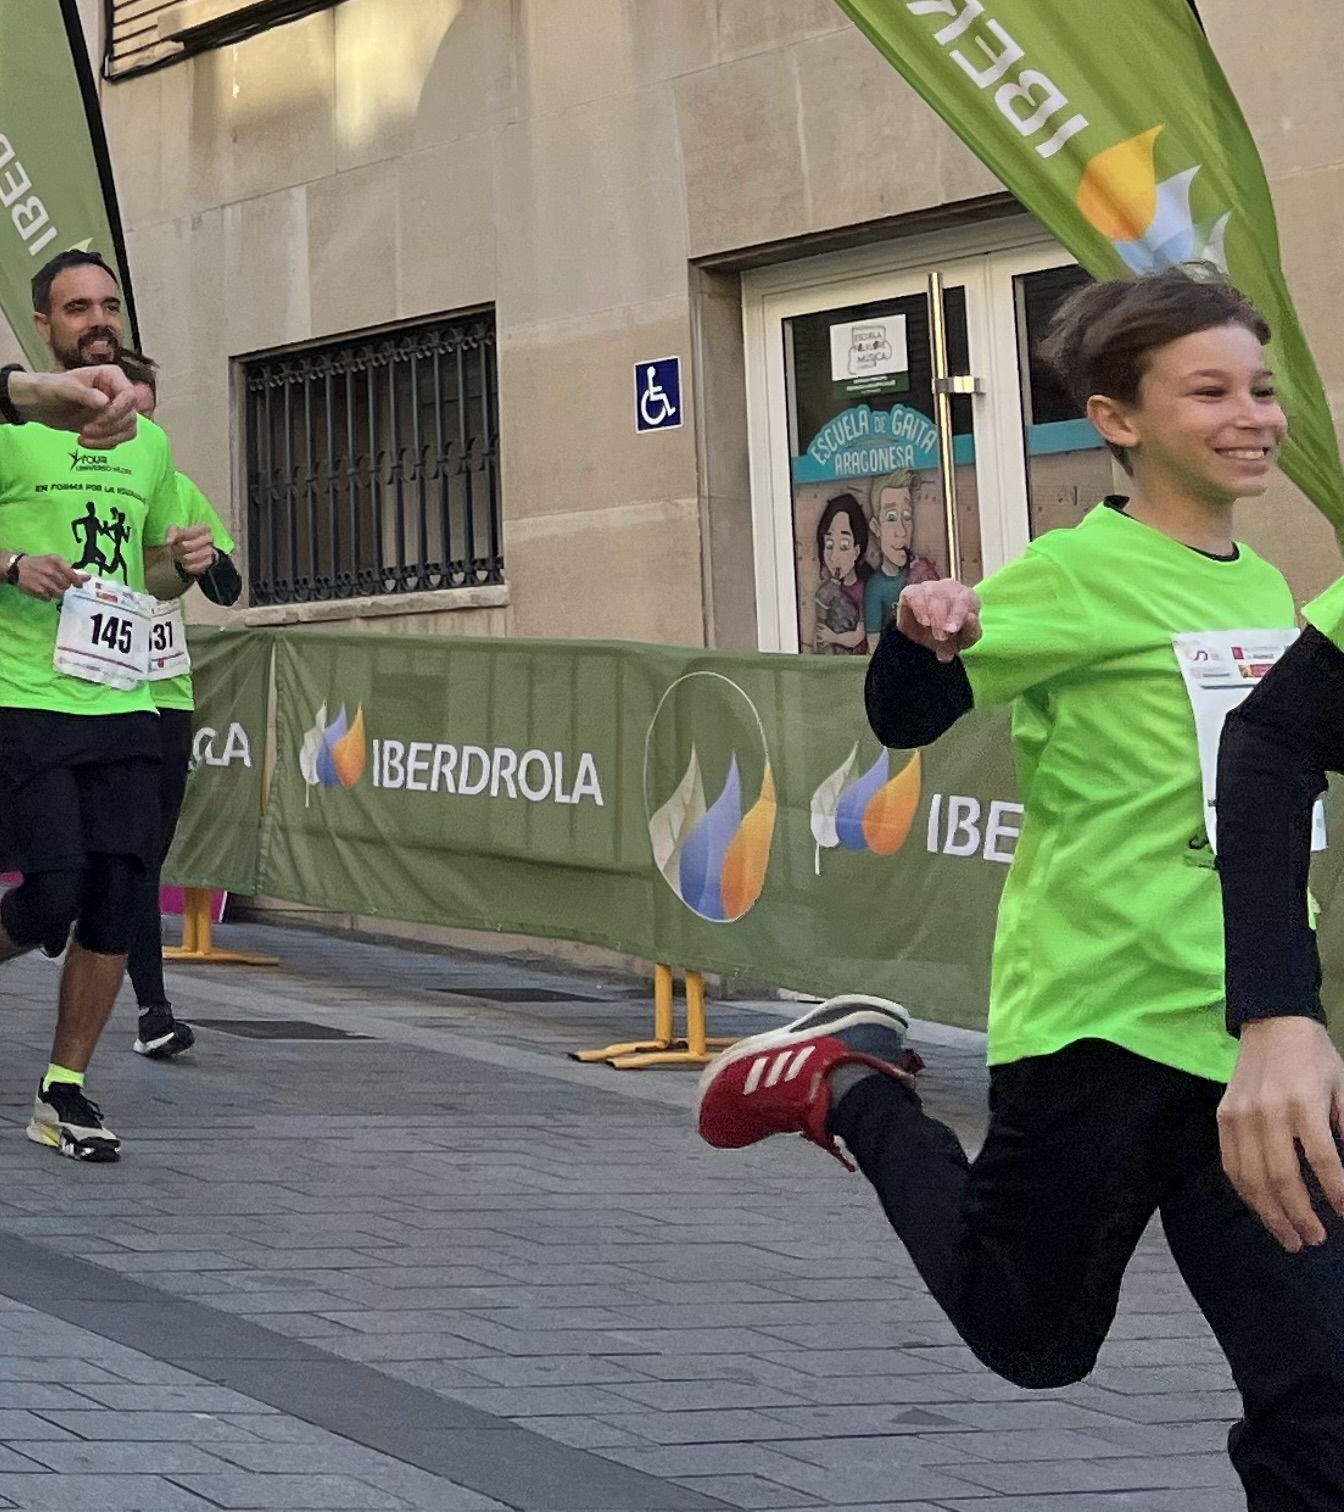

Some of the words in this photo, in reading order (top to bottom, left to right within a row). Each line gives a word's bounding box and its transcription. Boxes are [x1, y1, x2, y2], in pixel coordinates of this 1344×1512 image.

[812, 410, 869, 466] ESCUELA
[873, 416, 886, 434] DE
[892, 409, 938, 454] GAITA
[834, 445, 914, 476] ARAGONESA
[89, 613, 133, 654] 145
[149, 621, 173, 652] 31
[371, 737, 604, 808] IBERDROLA
